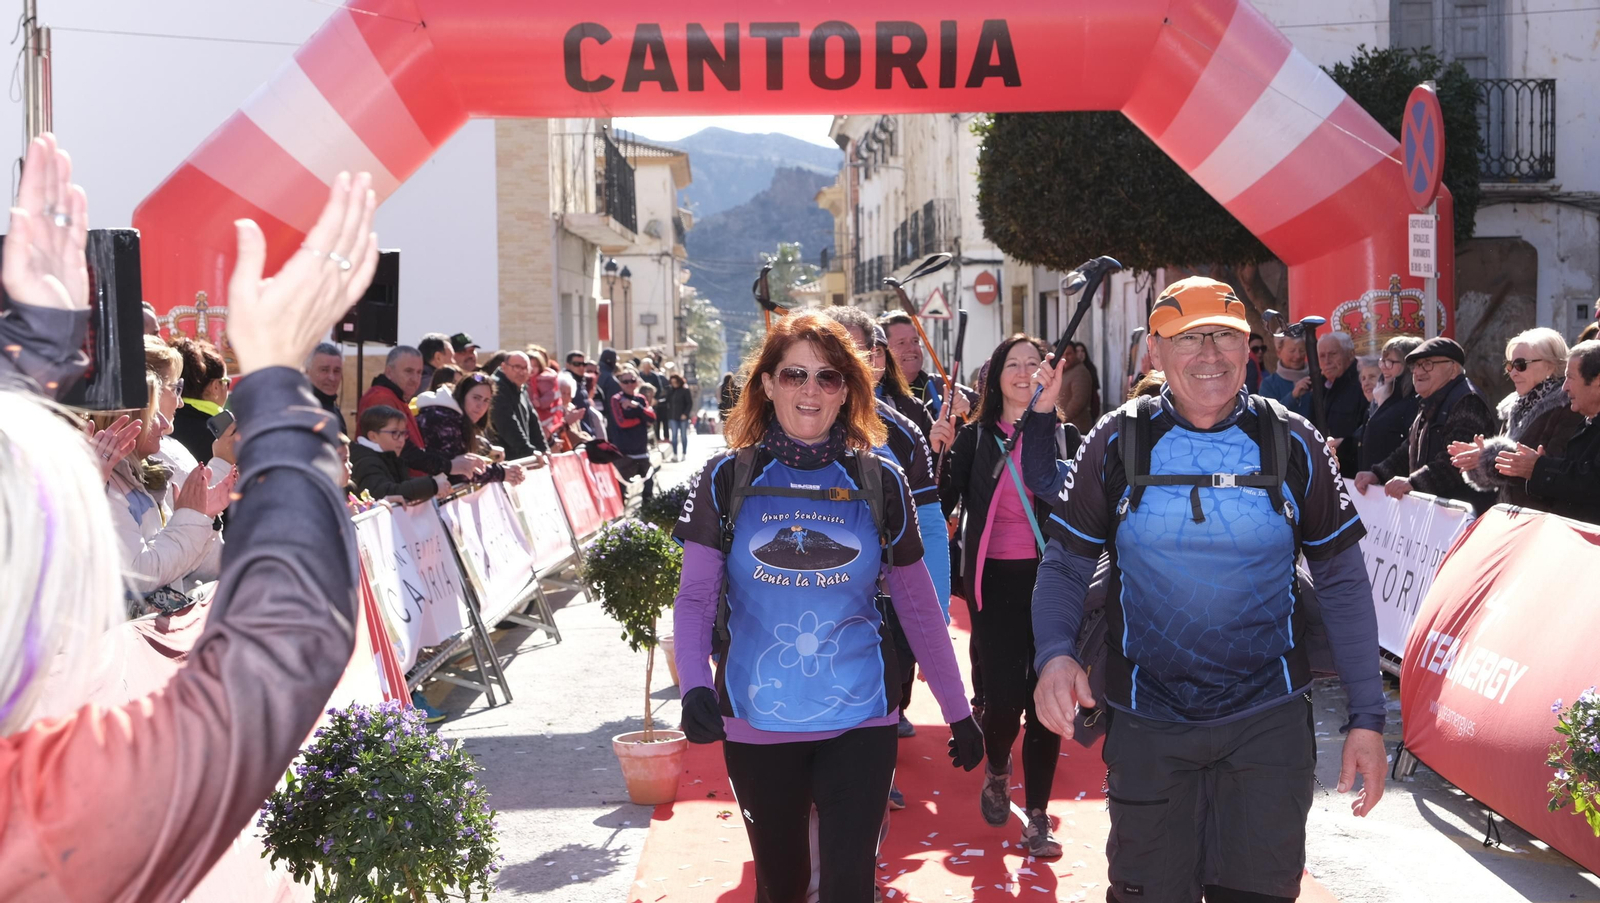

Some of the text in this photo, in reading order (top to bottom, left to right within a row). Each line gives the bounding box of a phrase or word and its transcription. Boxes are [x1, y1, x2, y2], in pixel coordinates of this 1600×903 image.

[563, 18, 1021, 92] CANTORIA
[761, 510, 845, 524] Grupo Senderista
[753, 565, 791, 587] Venta
[815, 571, 850, 588] Rata
